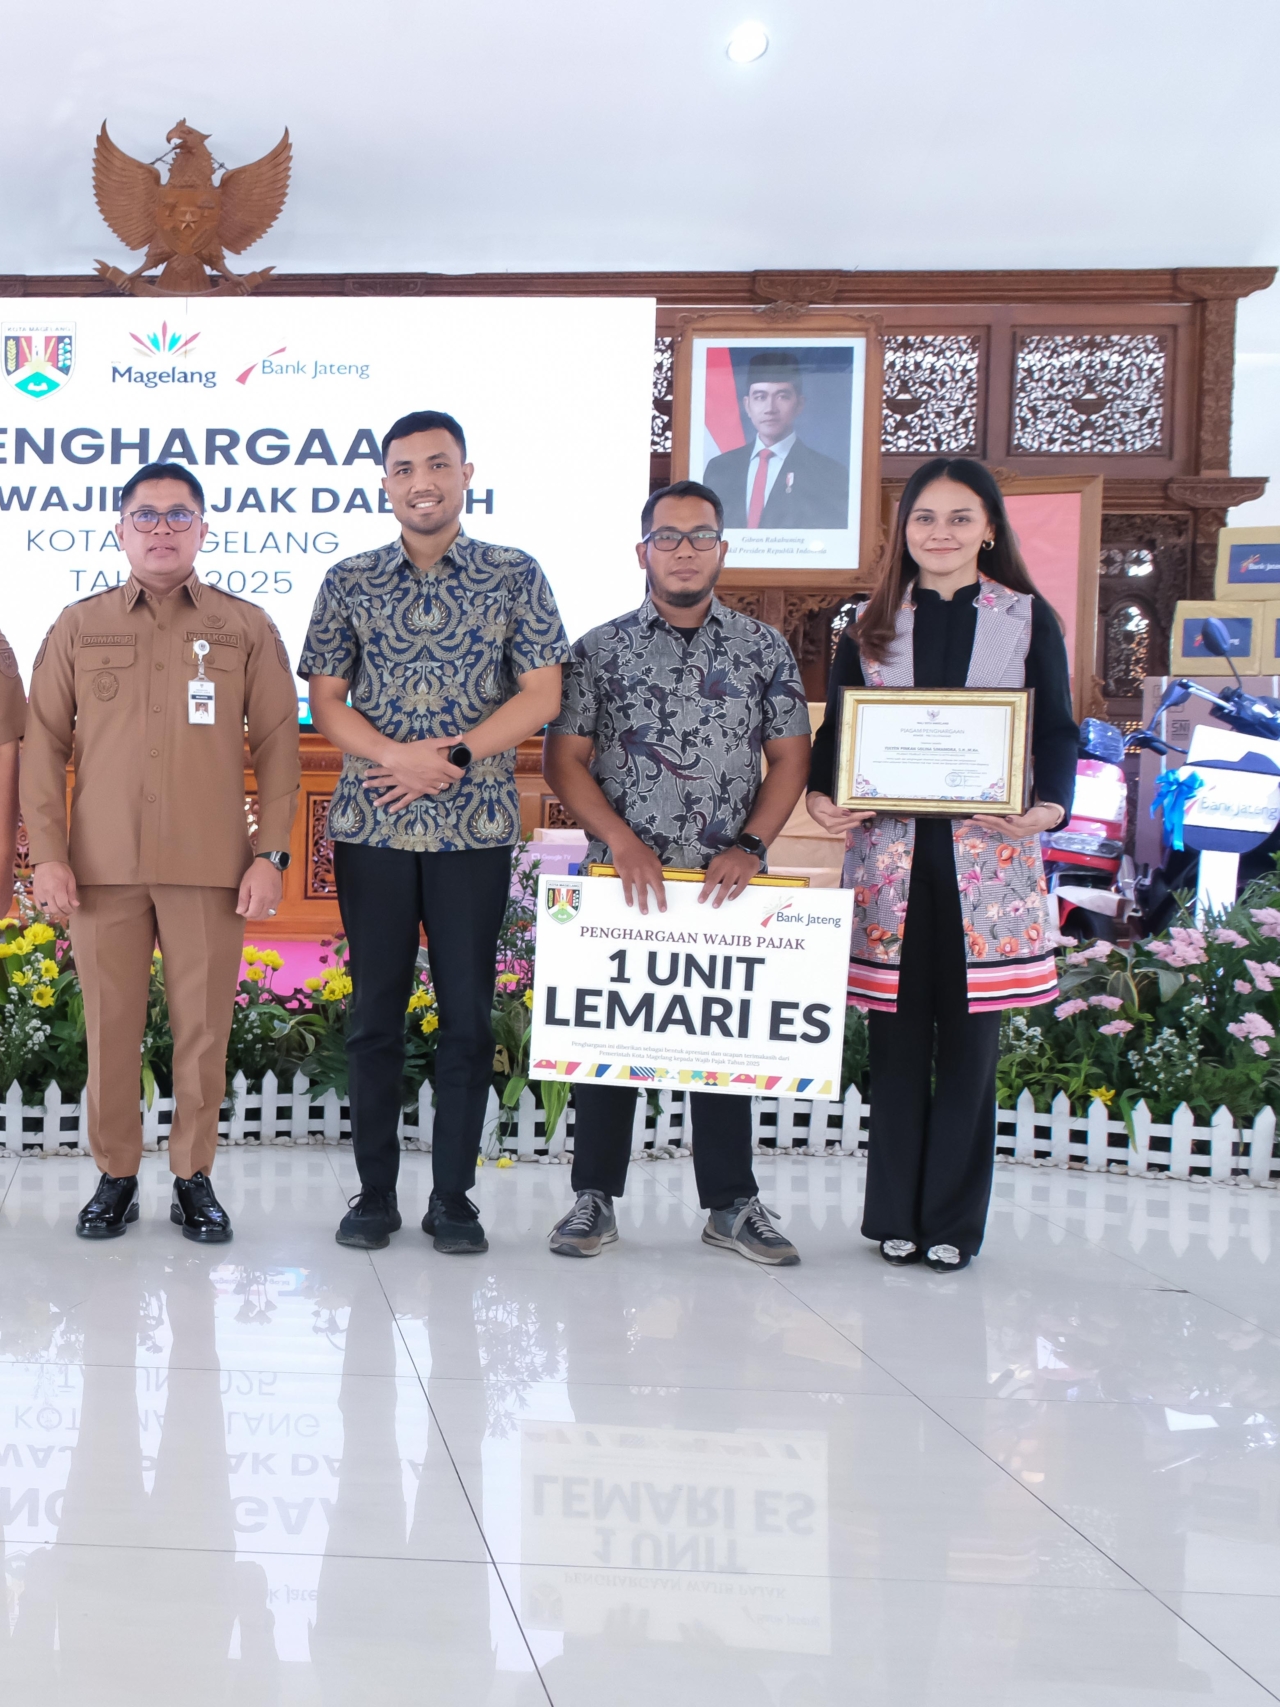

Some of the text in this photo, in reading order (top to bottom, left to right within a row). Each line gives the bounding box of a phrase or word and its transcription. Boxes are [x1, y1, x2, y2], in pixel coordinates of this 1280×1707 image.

[112, 366, 216, 388] Magelang
[262, 360, 370, 380] Bank Jateng
[27, 530, 121, 552] KOTA
[83, 636, 121, 644] DAMAR
[213, 634, 237, 644] KOTA
[1201, 797, 1278, 820] Bank Jateng
[776, 912, 842, 928] Bank Jateng
[580, 926, 806, 950] PENGHARGAAN WAJIB PAJAK
[608, 949, 766, 992] 1 UNIT
[545, 986, 832, 1044] LEMARI ES
